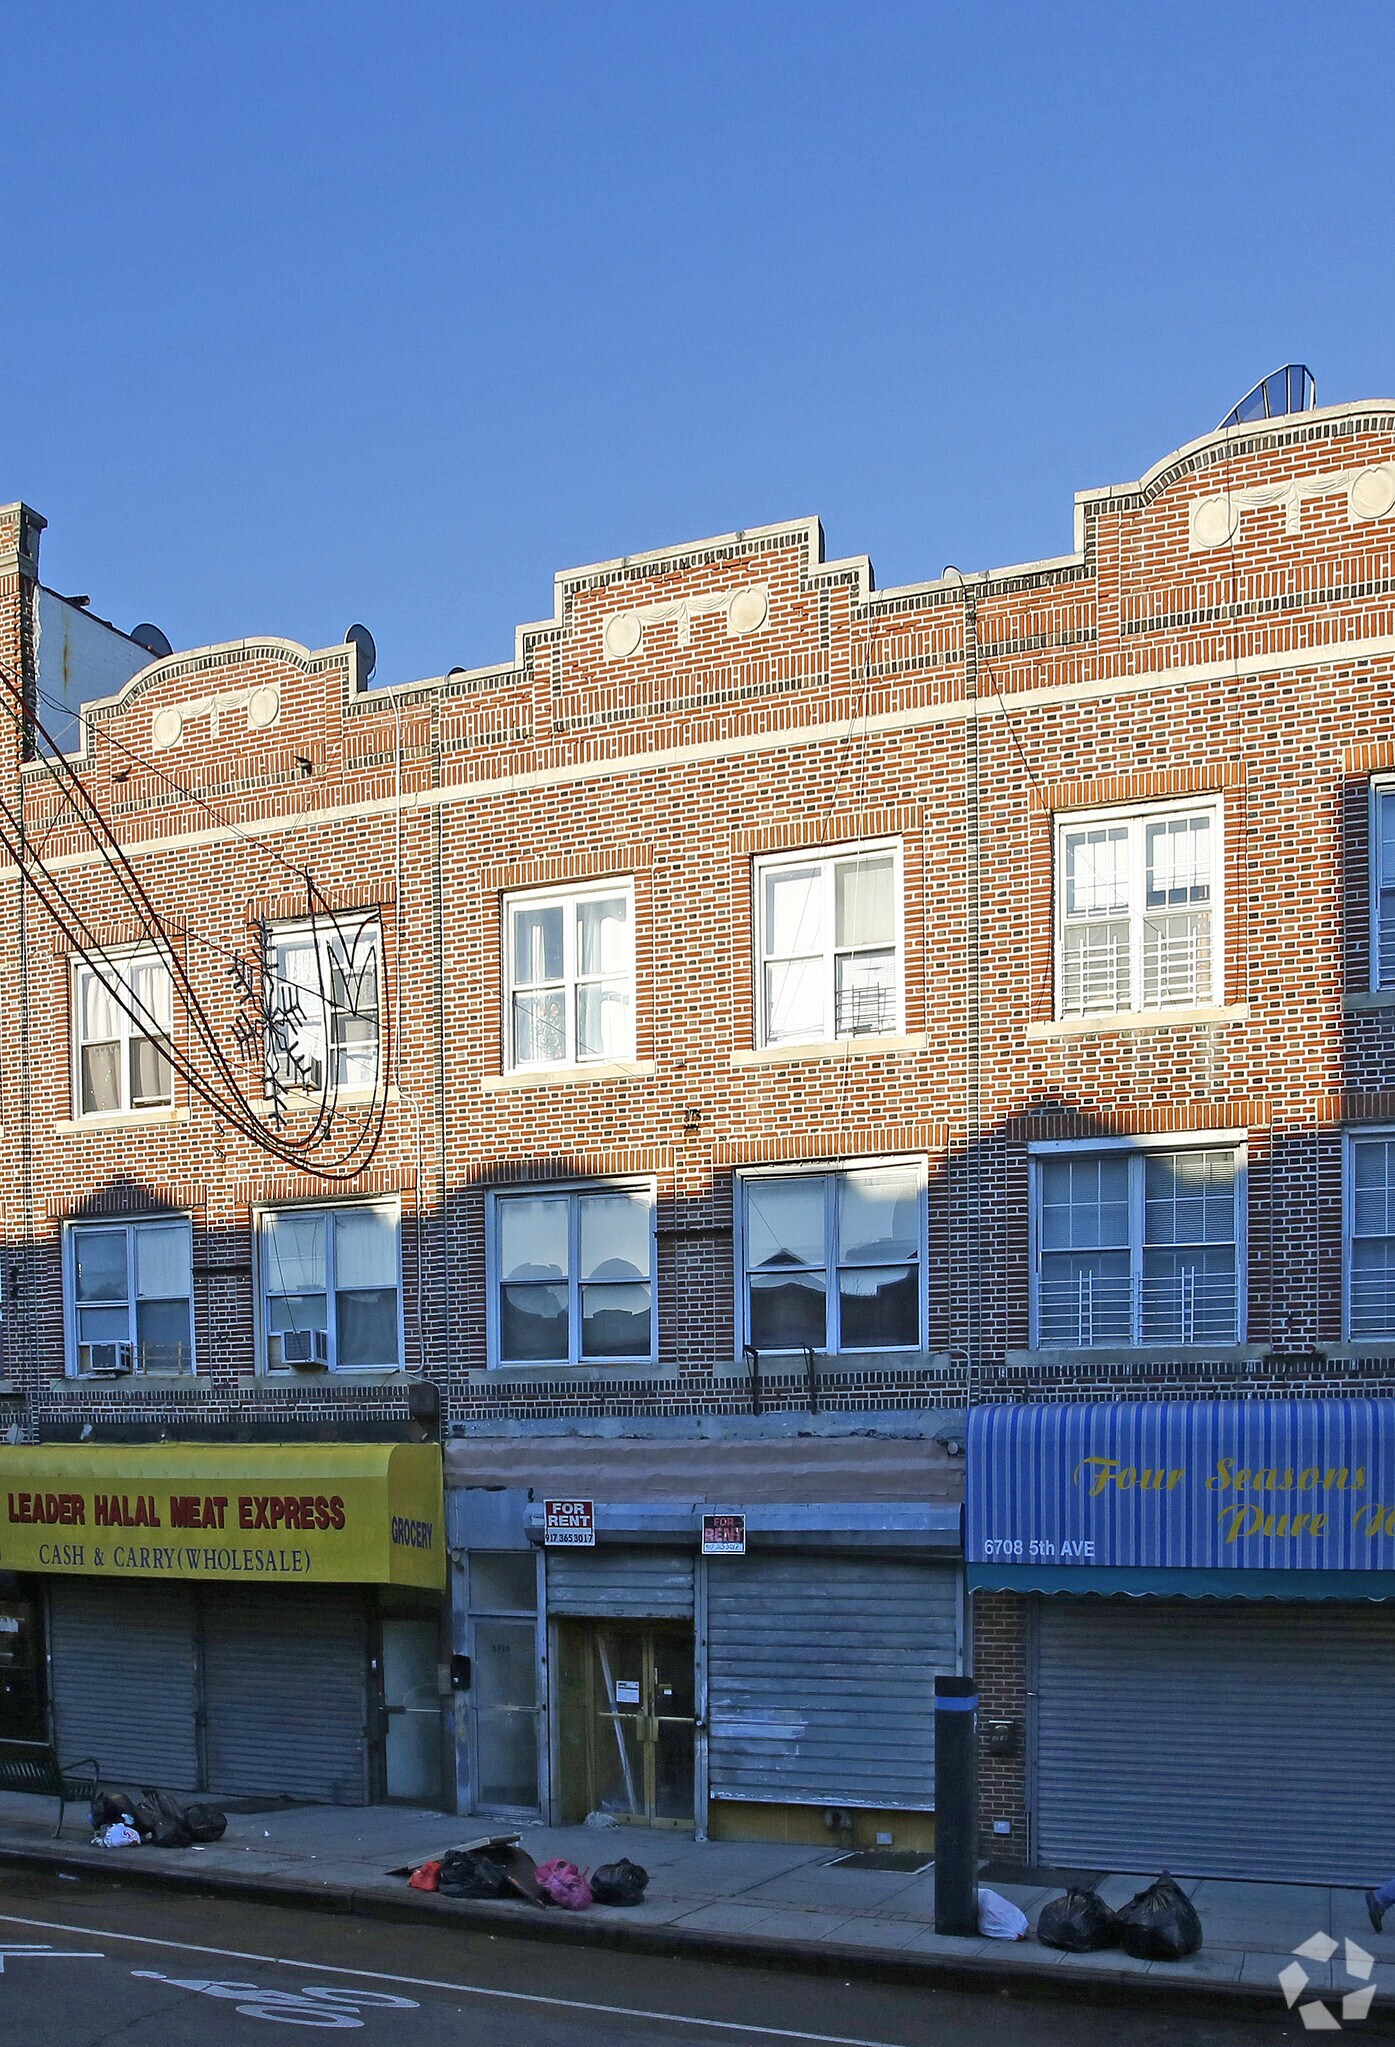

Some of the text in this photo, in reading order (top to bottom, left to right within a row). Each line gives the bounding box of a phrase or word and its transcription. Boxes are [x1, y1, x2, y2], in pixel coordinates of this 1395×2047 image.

[1074, 1456, 1367, 1497] Four Seasons
[8, 1493, 346, 1530] LEADER HALAL MEAT EXPRESS
[552, 1503, 585, 1514] FOR
[548, 1515, 590, 1527] RENT
[713, 1517, 734, 1526] FOR
[1217, 1503, 1329, 1544] Pure
[392, 1516, 432, 1549] GROCERY
[39, 1544, 85, 1566] CASH
[94, 1547, 105, 1566] &
[984, 1540, 1095, 1557] 6708 5th AVE
